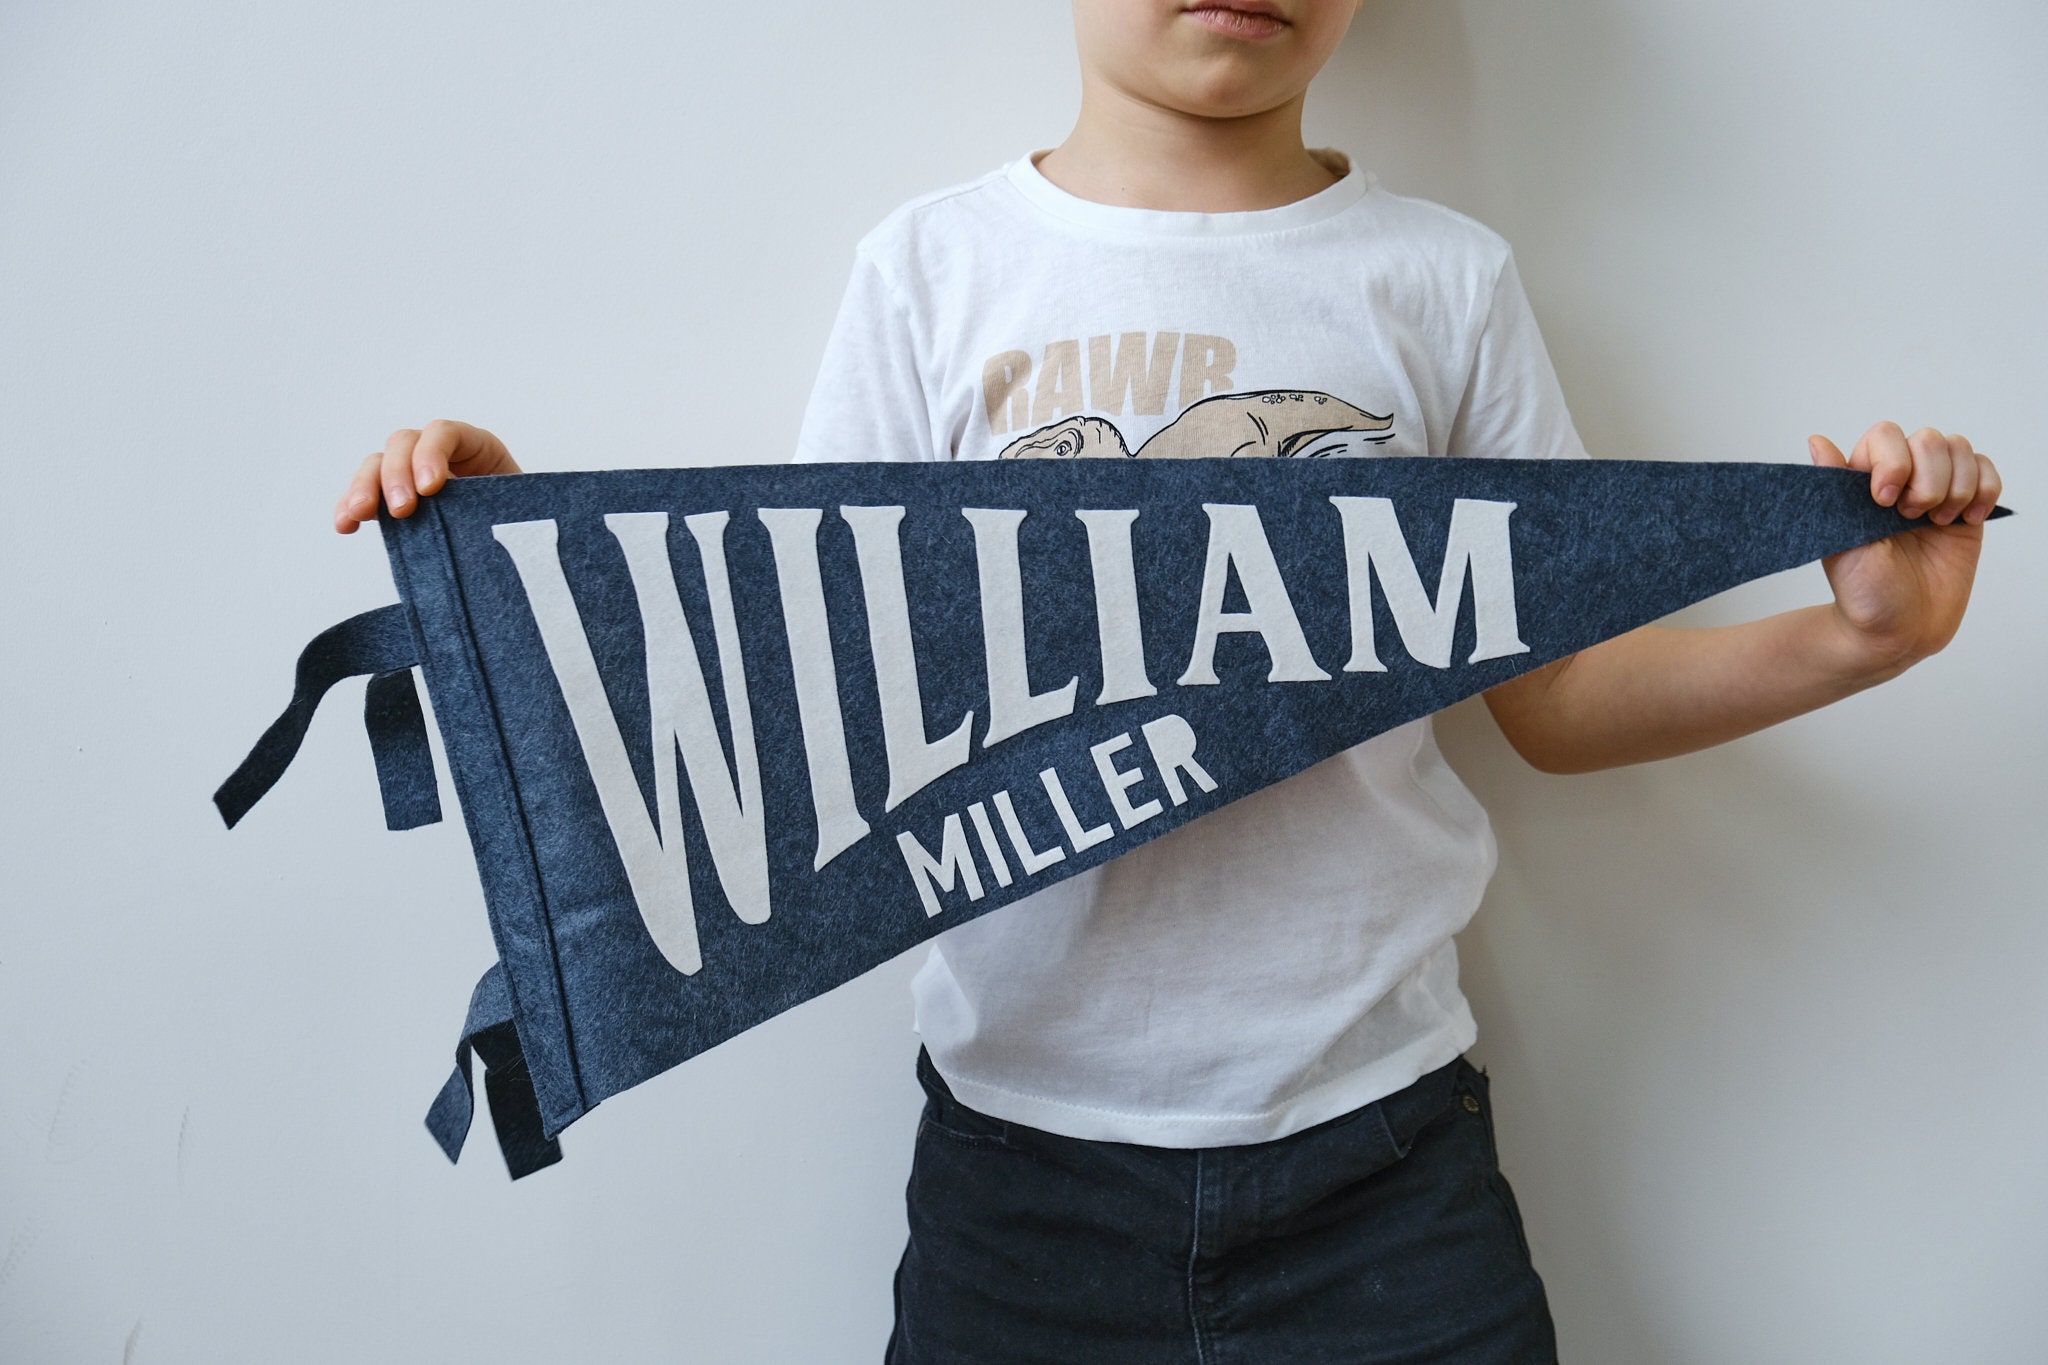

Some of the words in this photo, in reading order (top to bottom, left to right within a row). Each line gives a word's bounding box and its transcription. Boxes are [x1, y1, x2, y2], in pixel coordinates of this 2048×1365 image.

[982, 331, 1237, 436] RAWR
[491, 495, 1531, 976] WILLIAM
[896, 714, 1219, 919] MILLER
